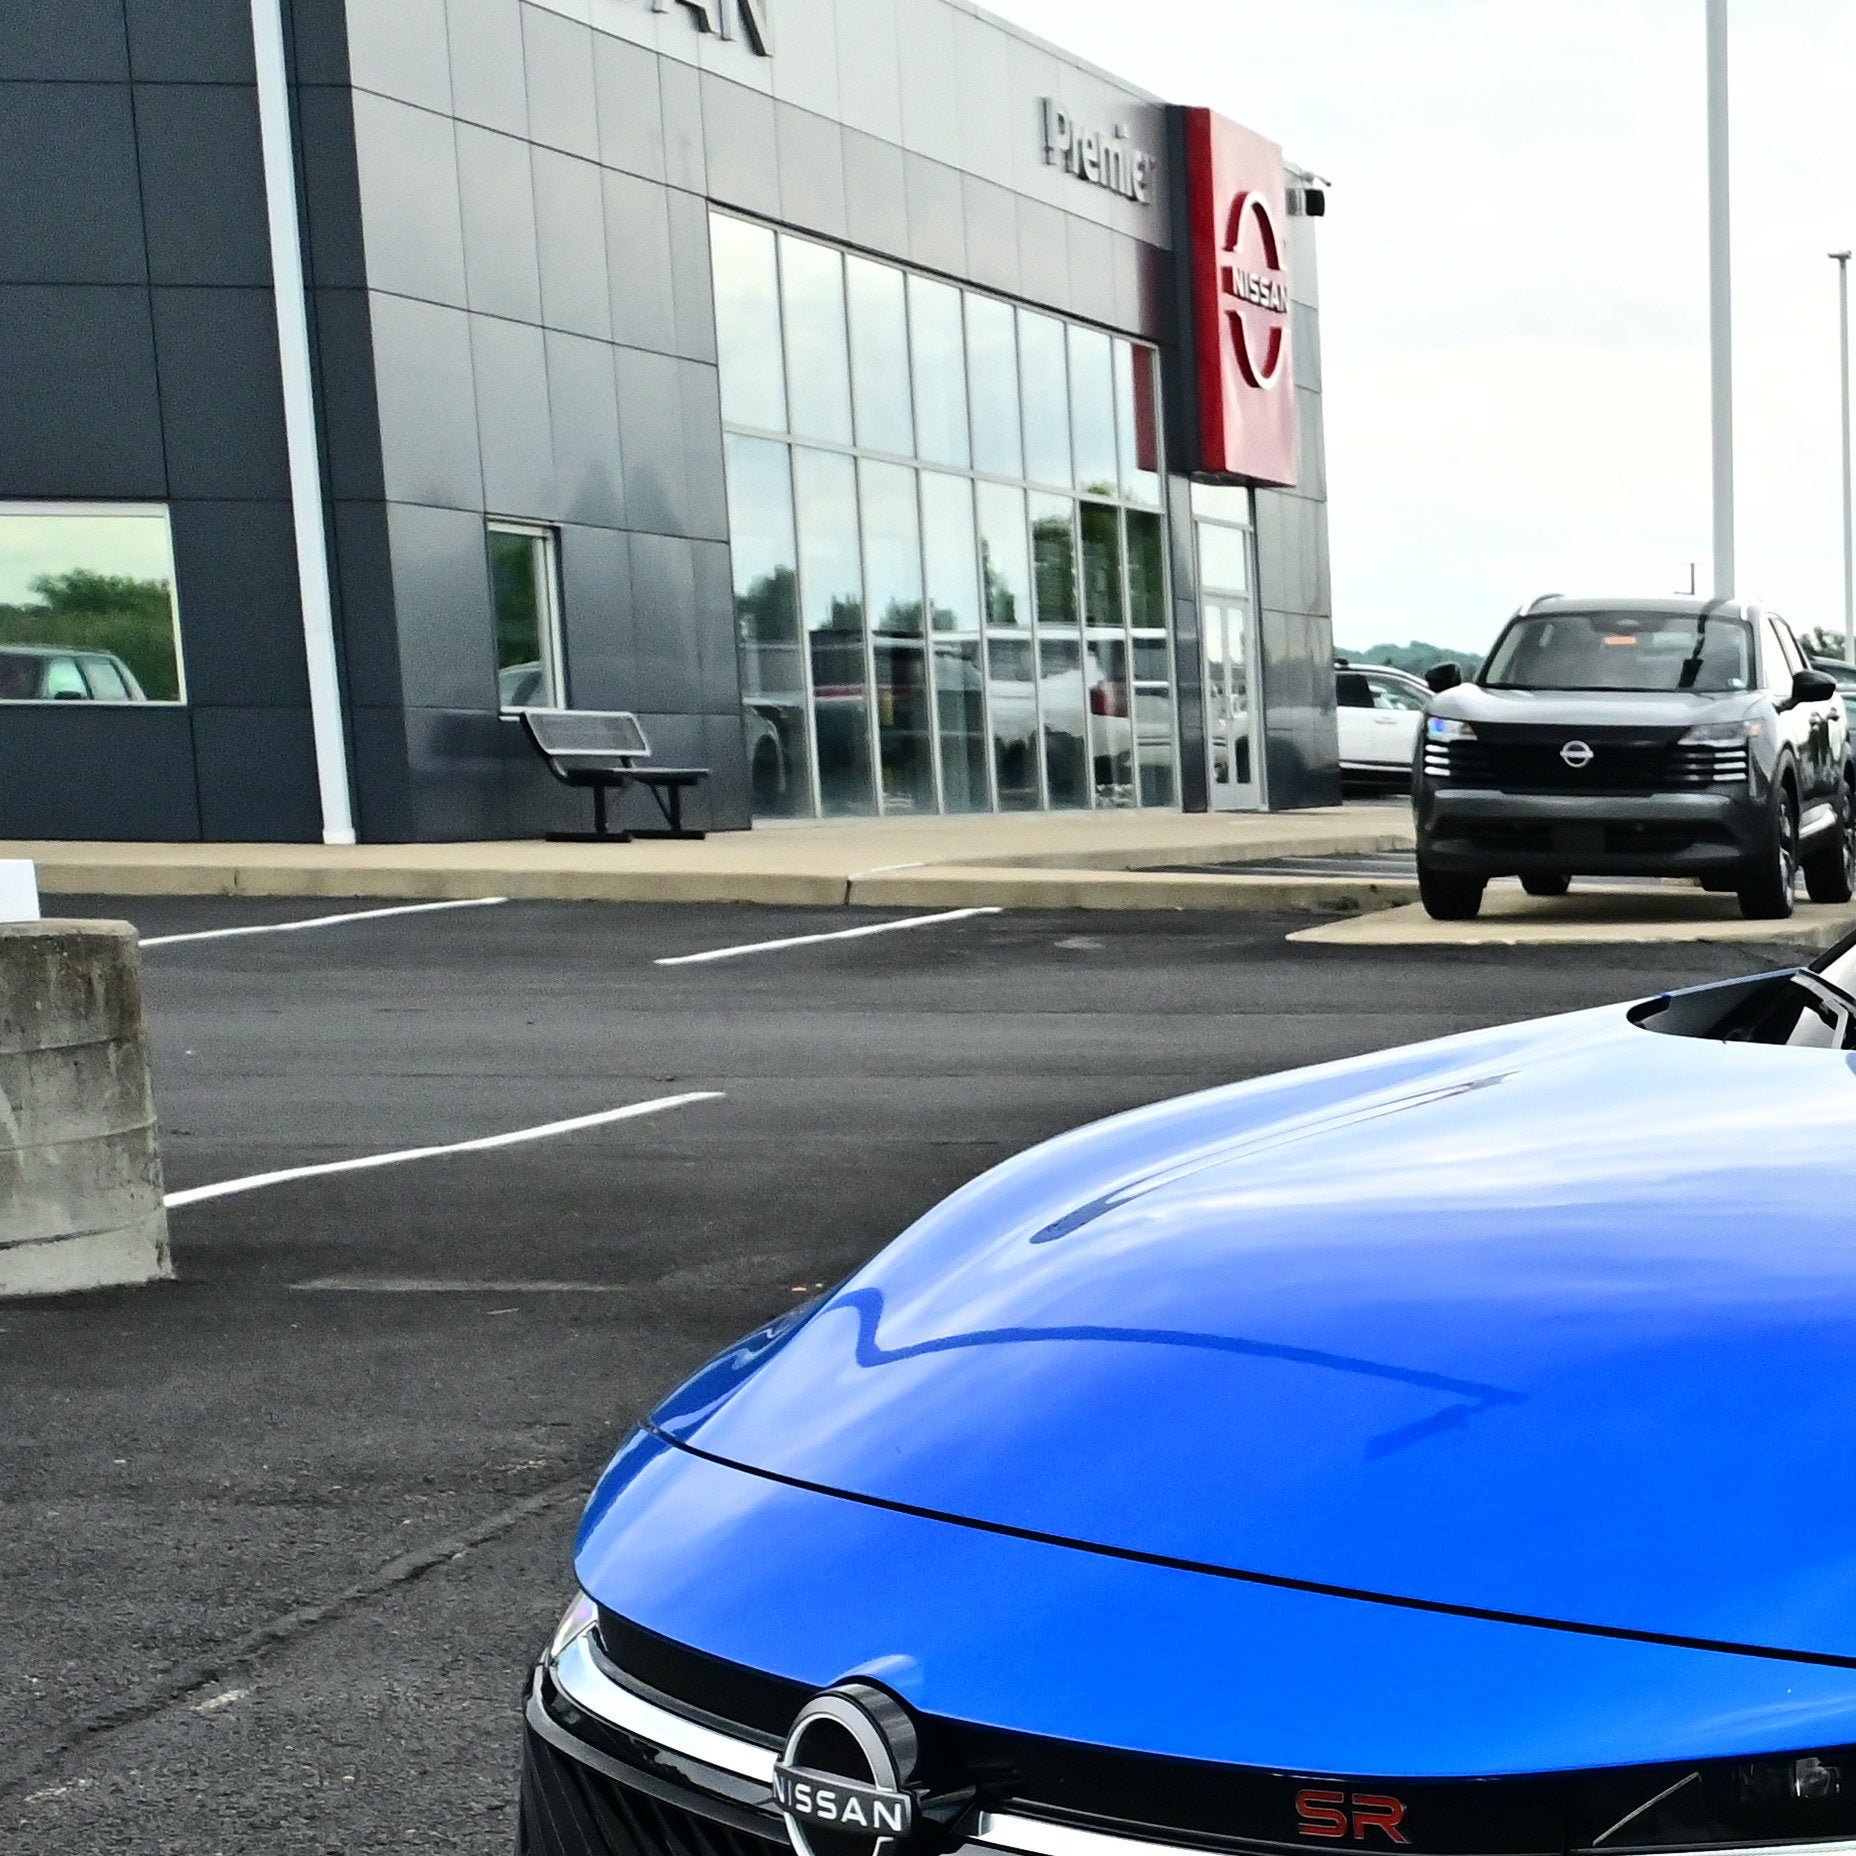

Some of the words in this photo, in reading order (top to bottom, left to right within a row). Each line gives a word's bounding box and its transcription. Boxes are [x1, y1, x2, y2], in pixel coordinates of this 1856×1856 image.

[1234, 267, 1288, 313] NISSAN
[773, 1770, 903, 1832] NISSAN
[1295, 1789, 1413, 1844] SR
